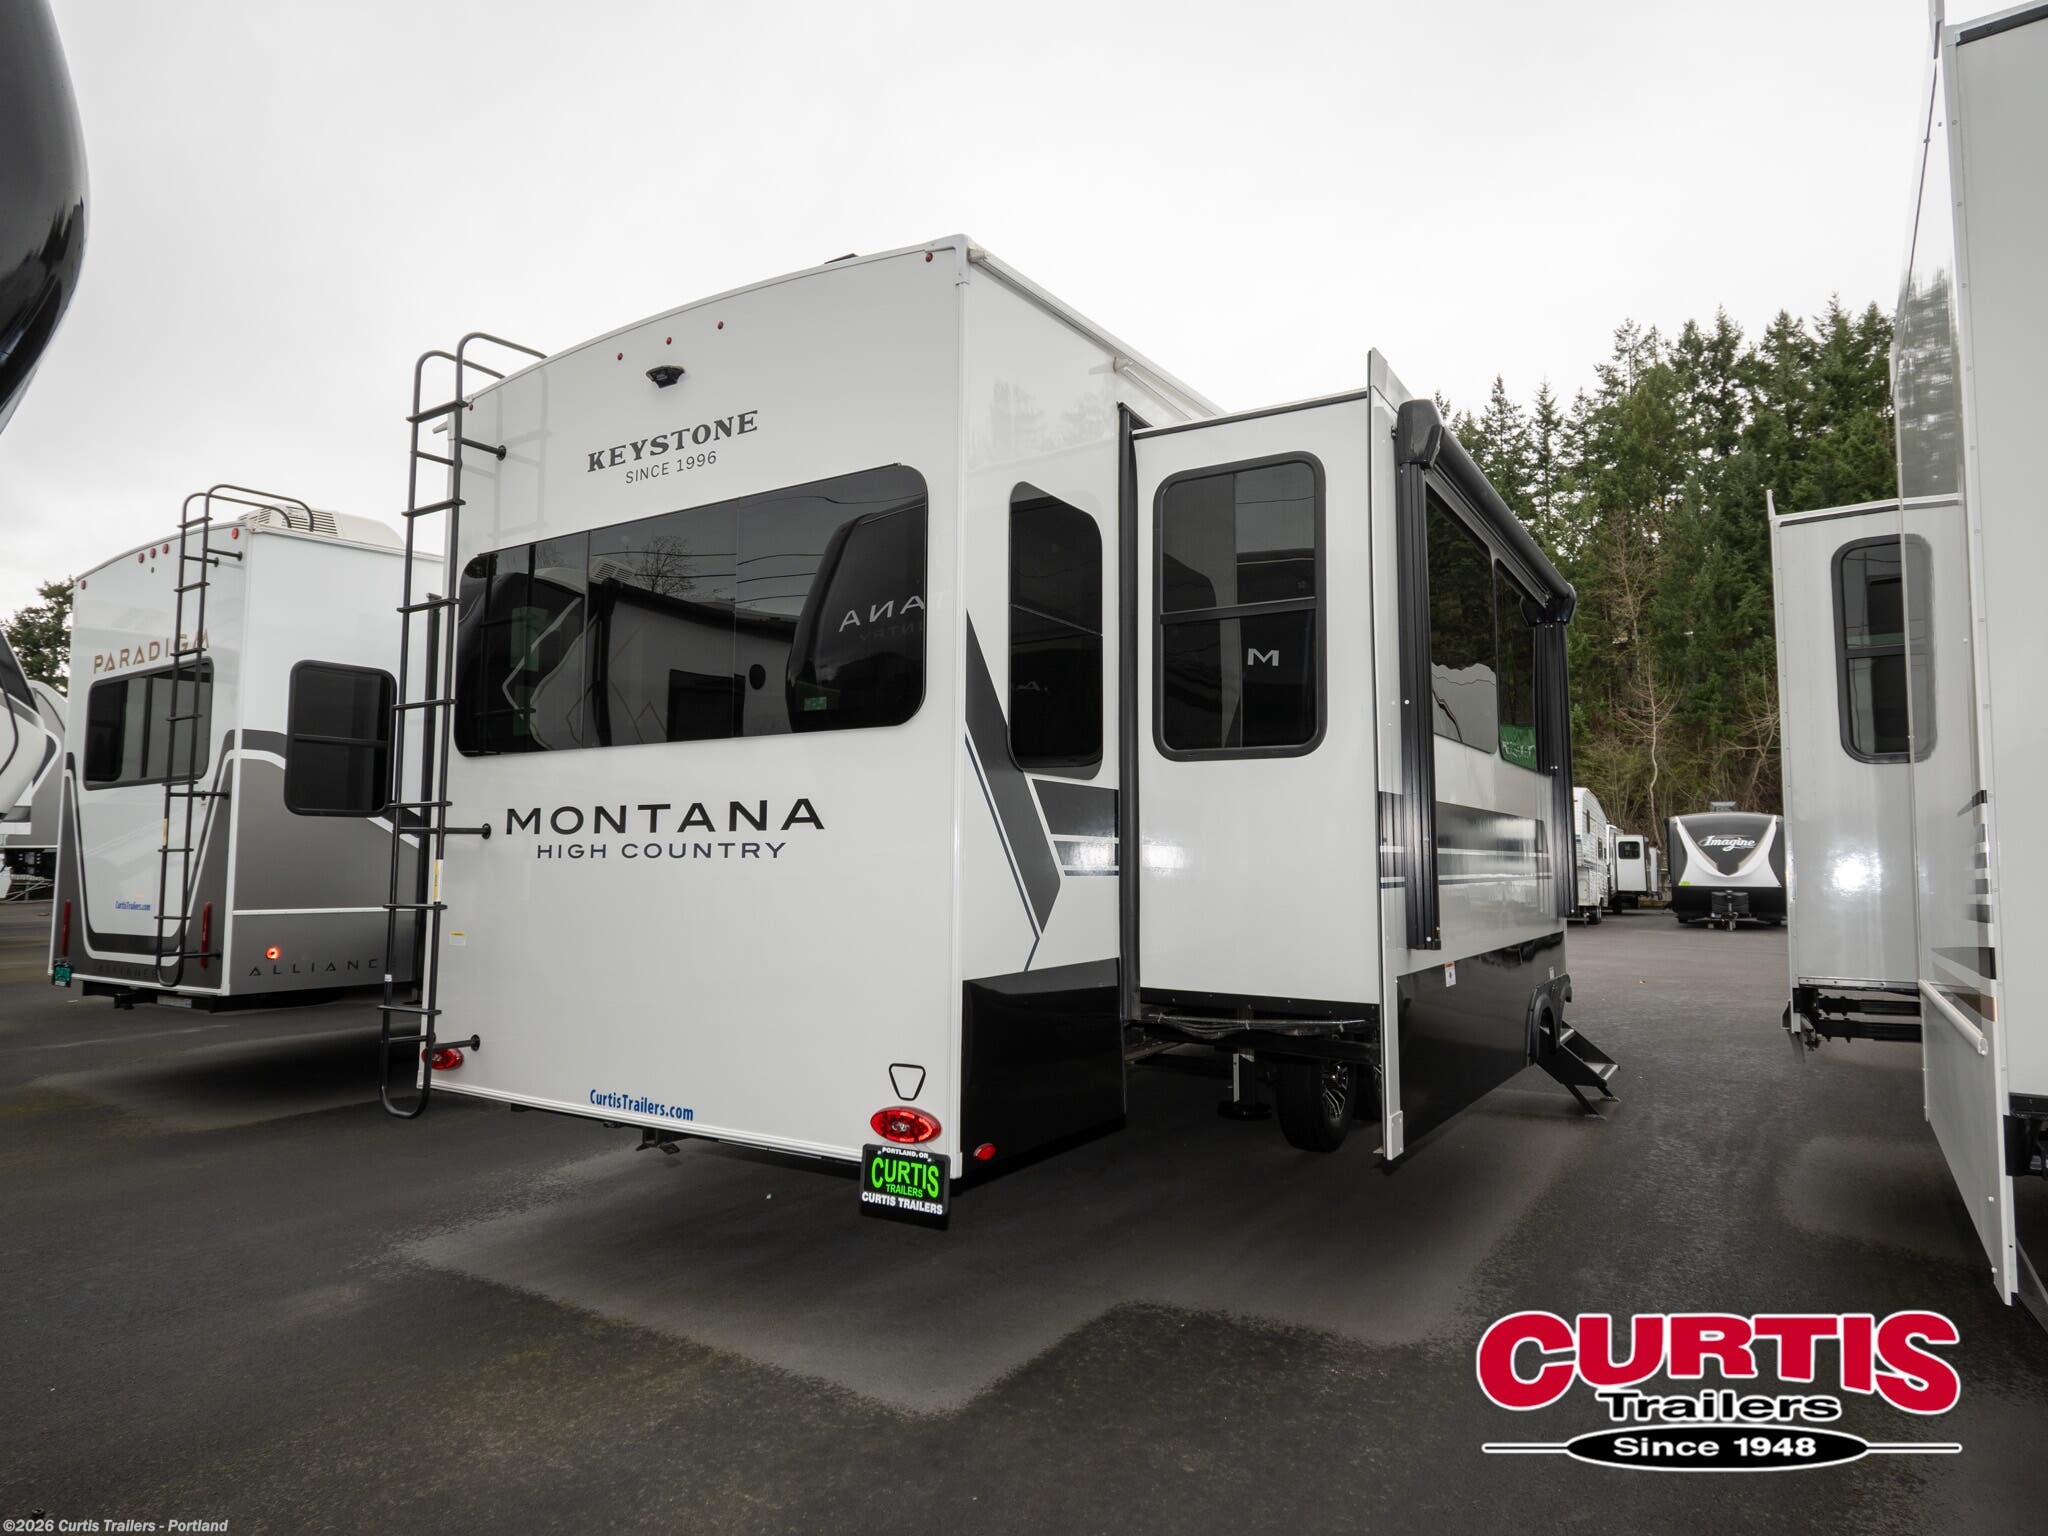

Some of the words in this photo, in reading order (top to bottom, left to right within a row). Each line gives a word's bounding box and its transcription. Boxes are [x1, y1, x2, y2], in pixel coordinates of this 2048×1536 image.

[587, 410, 758, 472] KEYSTONE
[625, 461, 670, 484] SINCE
[676, 450, 717, 473] 1996
[506, 798, 826, 836] MONTANA
[537, 844, 607, 859] HIGH
[621, 842, 787, 859] COUNTRY
[1704, 835, 1756, 852] Imagine
[590, 1089, 694, 1121] CurtisTrailers.com
[871, 1157, 940, 1199] CURTIS
[886, 1183, 923, 1198] TRAILERS
[862, 1191, 896, 1207] CURTIS
[898, 1197, 943, 1215] TRAILERS
